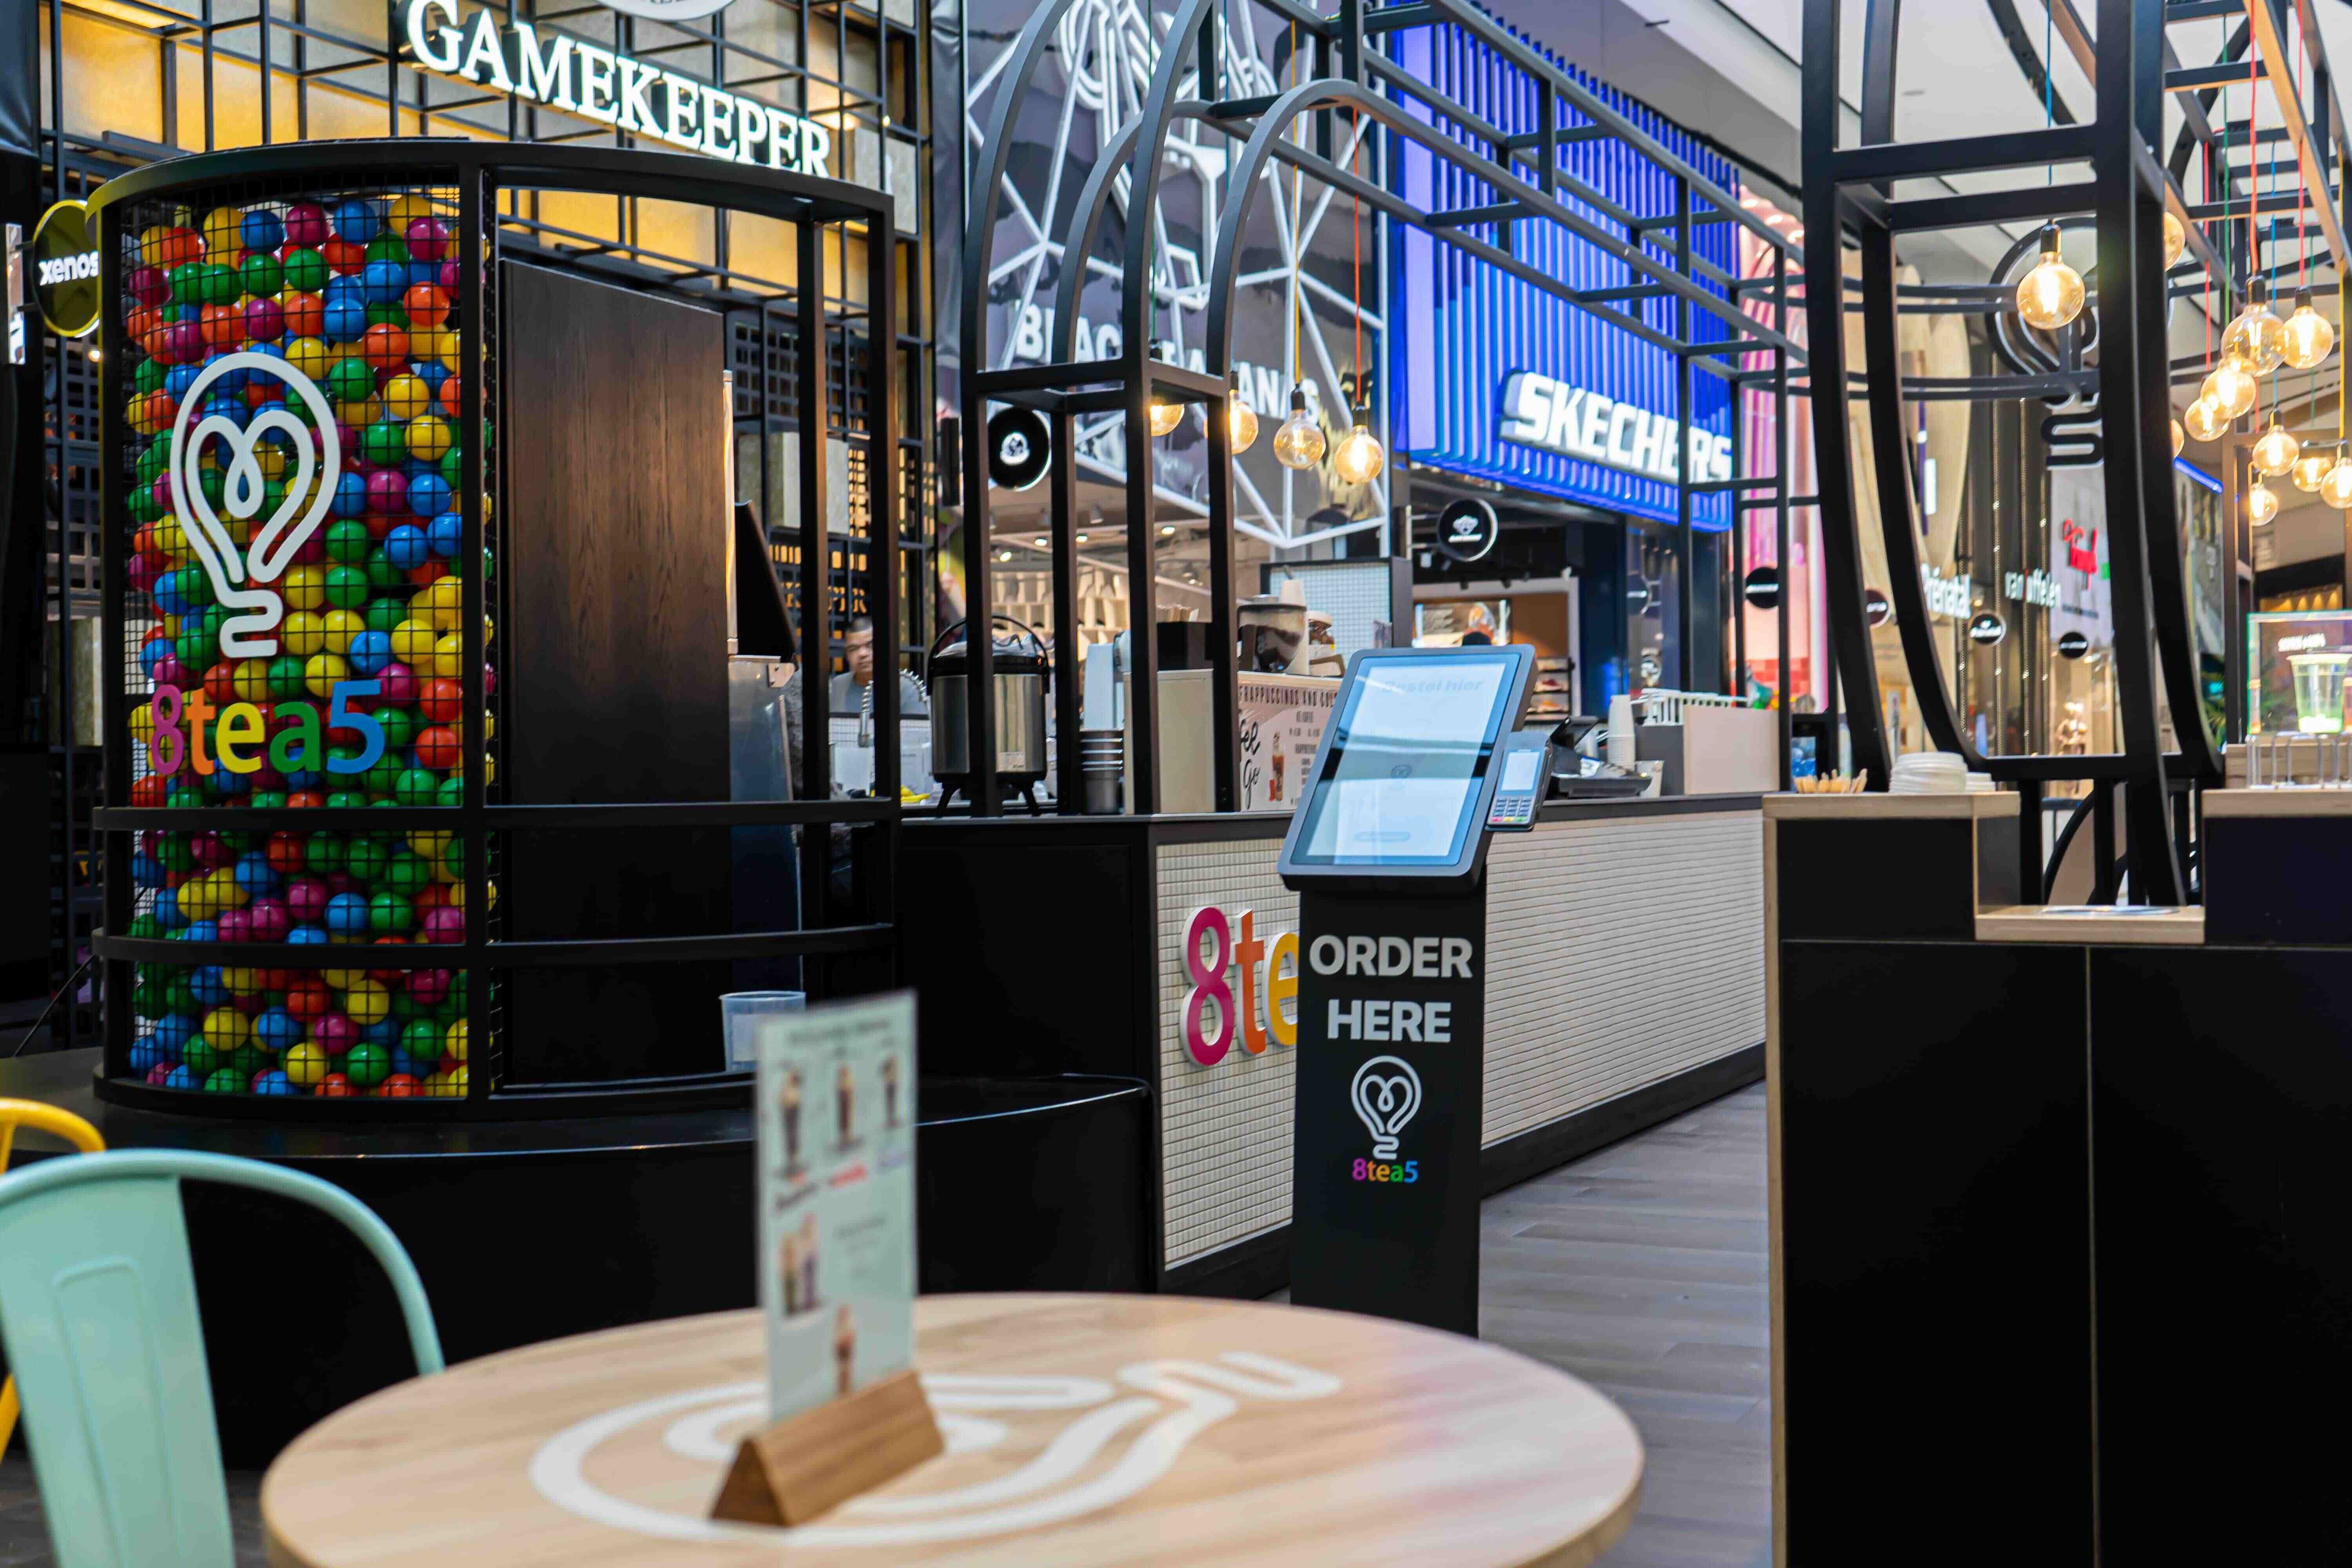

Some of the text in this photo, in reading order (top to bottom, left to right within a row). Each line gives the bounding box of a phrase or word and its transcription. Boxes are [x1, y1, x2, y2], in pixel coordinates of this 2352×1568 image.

[407, 0, 830, 178] GAMEKEEPER
[39, 250, 99, 286] xenos
[1015, 300, 1123, 365] BLAC
[1501, 372, 1732, 483] SKECHERS
[151, 680, 385, 775] 8tea5
[1180, 906, 1299, 1066] 8te
[1309, 935, 1473, 978] ORDER
[1327, 999, 1452, 1043] HERE
[1352, 1158, 1418, 1183] 8tea5
